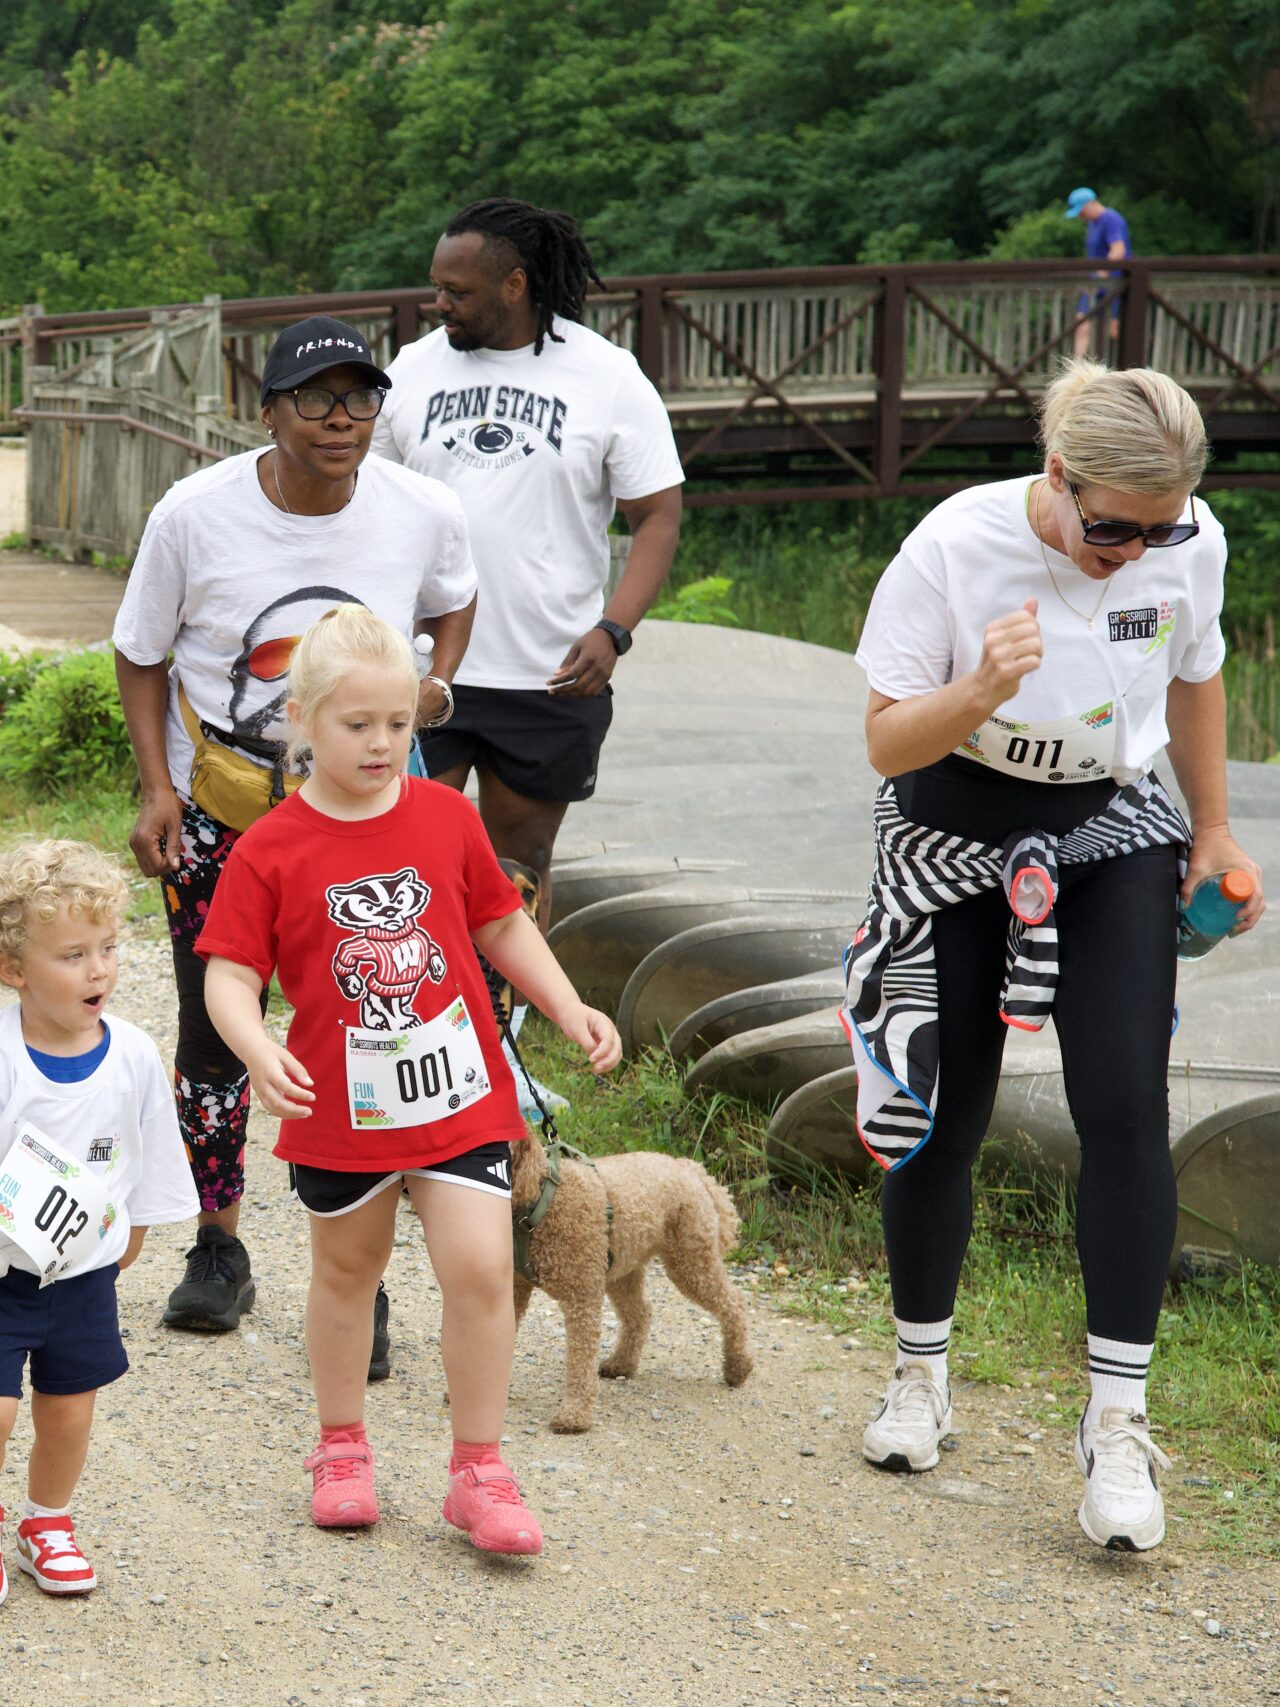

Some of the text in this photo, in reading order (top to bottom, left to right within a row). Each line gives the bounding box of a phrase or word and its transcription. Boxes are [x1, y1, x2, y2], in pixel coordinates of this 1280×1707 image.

[420, 384, 569, 456] PENN STATE
[452, 446, 492, 469] NITTANY
[1111, 621, 1156, 641] HEALTH
[1006, 737, 1064, 769] 011
[354, 1082, 375, 1099] FUN
[396, 1046, 453, 1103] 001
[34, 1185, 89, 1256] 012
